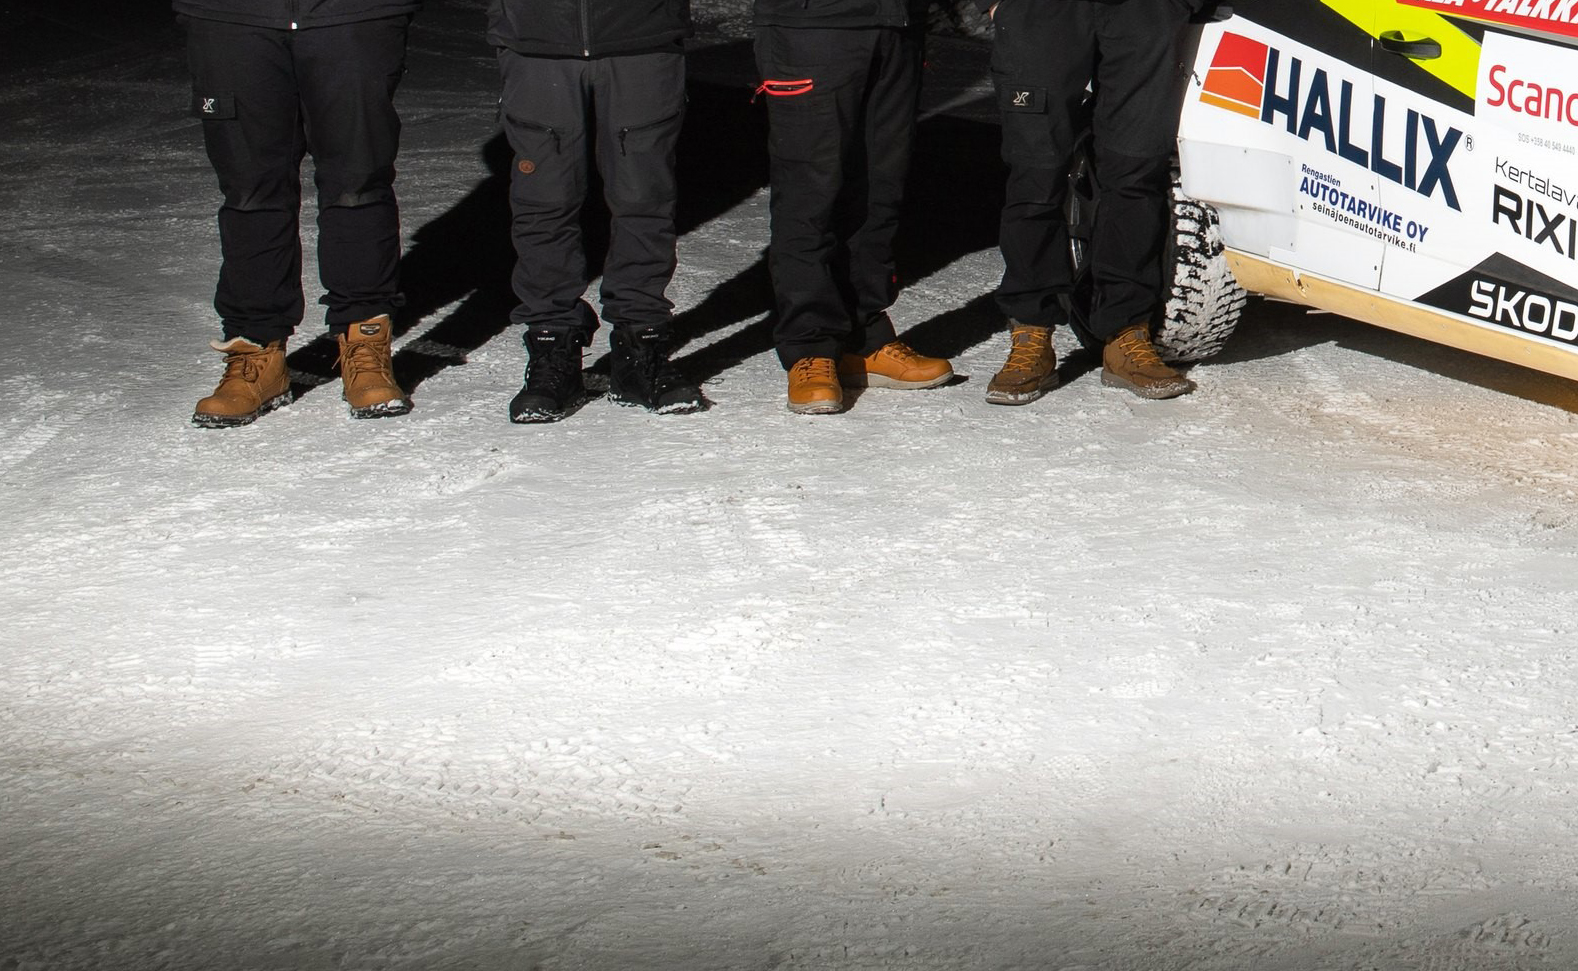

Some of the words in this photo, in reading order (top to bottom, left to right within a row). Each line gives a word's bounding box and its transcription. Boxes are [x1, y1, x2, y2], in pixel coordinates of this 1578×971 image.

[1261, 46, 1463, 213] HALLIX
[1301, 163, 1341, 187] Rengastien
[1299, 176, 1403, 233] AUTOTARVIKE
[1406, 221, 1429, 243] OY
[1312, 201, 1416, 254] seinäjoenautotarvike.fi
